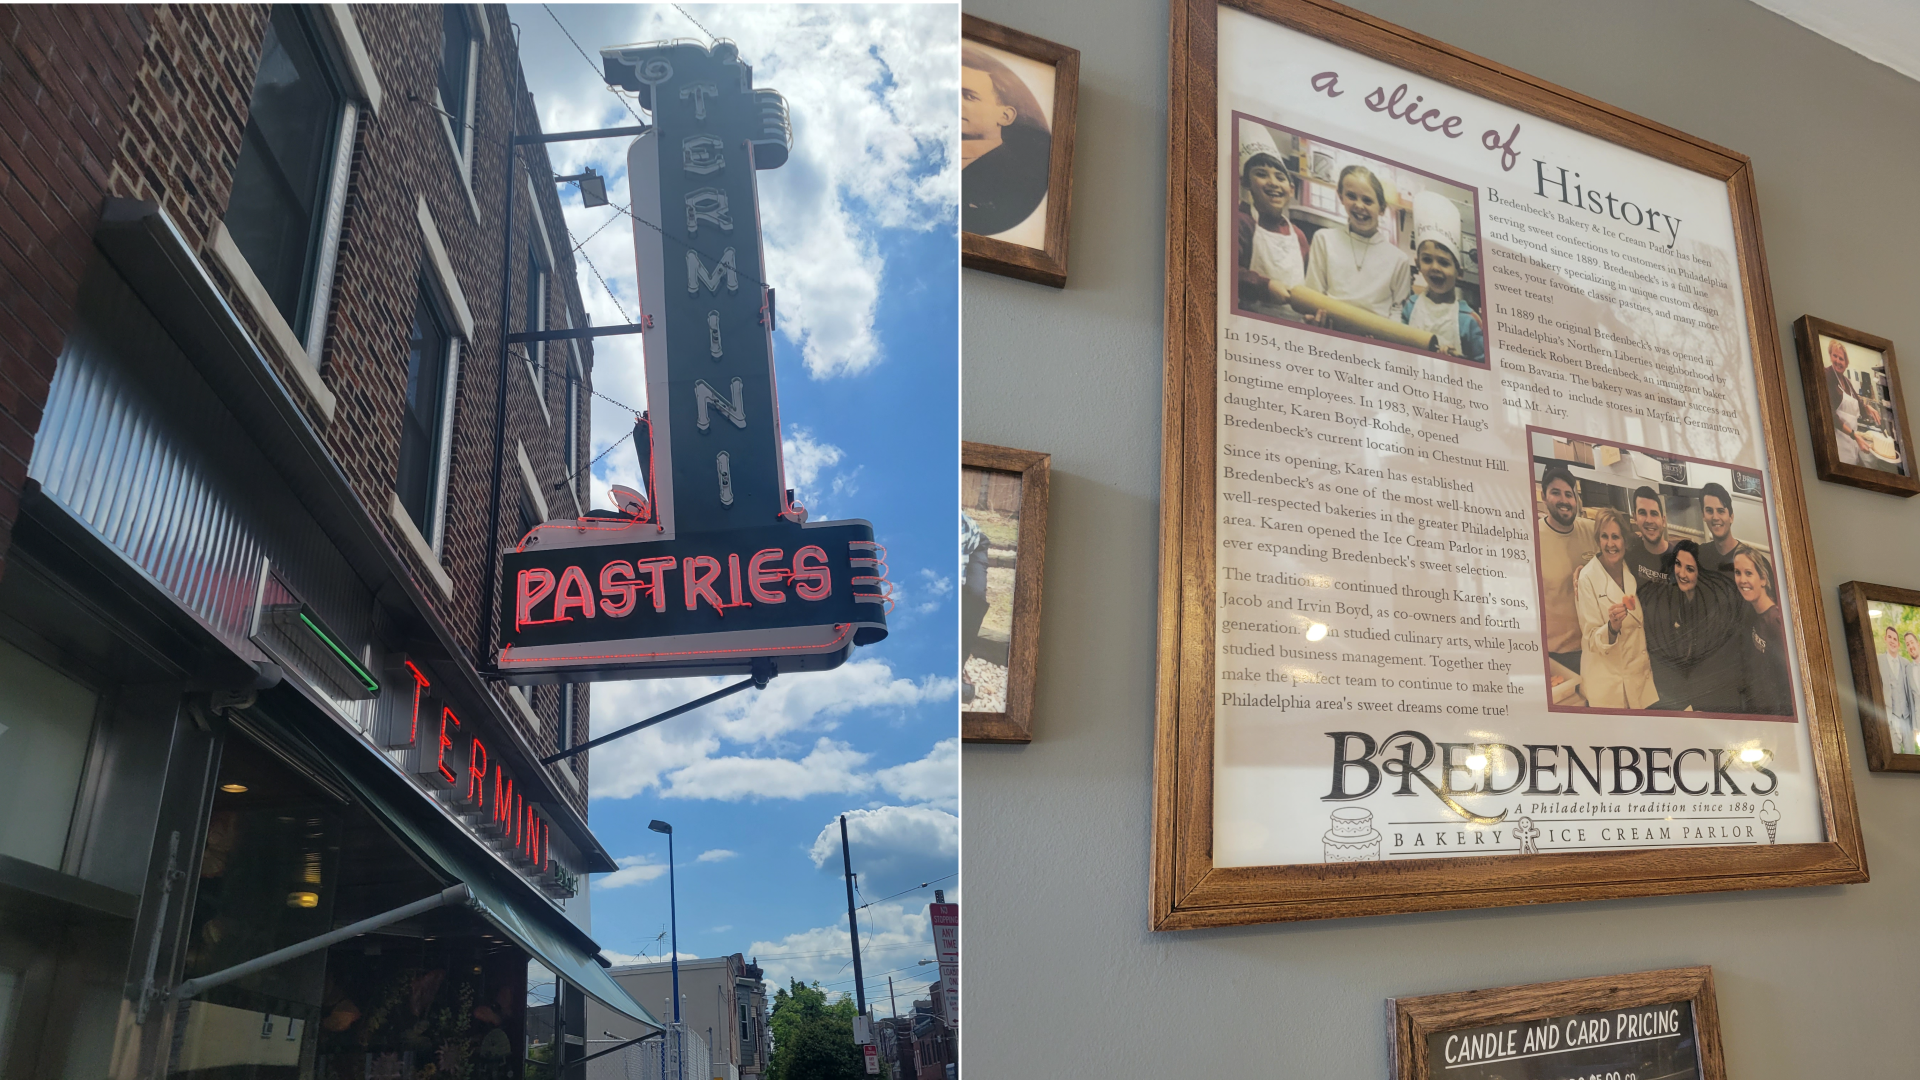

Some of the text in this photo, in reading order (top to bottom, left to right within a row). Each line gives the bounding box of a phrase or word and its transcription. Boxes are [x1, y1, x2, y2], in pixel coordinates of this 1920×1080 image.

[1311, 71, 1521, 172] a slice of
[1532, 158, 1682, 249] History
[1488, 214, 1728, 289] serving sweet confections to customers in Philadelphia
[1557, 211, 1590, 233] Bakery
[1590, 221, 1600, 233] &
[1602, 225, 1616, 238] Ice
[1617, 230, 1646, 248] Cream
[1648, 239, 1674, 256] Parlor
[1675, 247, 1690, 261] has
[1691, 252, 1712, 267] been
[679, 81, 747, 506] TERMINI
[1491, 248, 1719, 318] scratch bakery specializing in unique custom design
[1494, 283, 1554, 304] sweet treats!
[1224, 327, 1483, 391] In 1954, the Bredenbeck family handed the
[1496, 302, 1508, 315] In
[1511, 306, 1535, 321] 1889
[1536, 313, 1553, 326] the
[1554, 319, 1592, 336] original
[1653, 346, 1671, 356] was
[1671, 350, 1704, 364] opened
[1704, 354, 1714, 366] in
[1498, 339, 1547, 359] Frederick
[1548, 350, 1582, 367] Robert
[1642, 376, 1654, 384] an
[1656, 374, 1701, 395] immigrant
[1702, 385, 1726, 400] baker
[1567, 337, 1612, 357] Northern
[1614, 348, 1653, 367] Liberties
[1654, 360, 1715, 382] neighborhood
[1715, 372, 1727, 388] by
[1223, 369, 1489, 432] longtime employees. In 1983, Walter Haug's
[1223, 391, 1459, 444] daughter, Karen Boyd-Rohde, opened
[1501, 379, 1550, 395] expanded
[1552, 388, 1563, 398] to
[1567, 389, 1603, 406] include
[1604, 400, 1633, 413] stores
[1634, 404, 1644, 416] in
[1683, 414, 1741, 436] Germantown
[1502, 397, 1522, 408] and
[1223, 413, 1509, 472] Bredenbeck's current location in Chestnut Hill.
[1223, 443, 1474, 492] Since its opening, Karen has established
[1222, 516, 1529, 562] area. Karen opened the Ice Cream Parlor in 1983,
[1223, 490, 1530, 542] well-respected bakeries in the greater Philadelphia
[1222, 539, 1508, 578] ever expanding Bredenbeck's sweet selection.
[516, 545, 831, 630] PASTRIES
[1221, 592, 1520, 629] Jacob and Irvin Boyd, as co-owners and fourth
[1222, 643, 1512, 675] studied business management. Together they
[1222, 693, 1509, 716] Philadelphia area's sweet dreams come true!
[405, 660, 548, 871] TERMINI
[1514, 801, 1755, 816] A Philadelphia tradition since 1889
[1394, 825, 1754, 847] BAKERY ICE CREAM PARLOR
[940, 906, 948, 914] NO
[942, 928, 954, 938] ANY
[942, 939, 957, 949] TIME
[1445, 1009, 1679, 1064] CANDLE AND CARD PRICING
